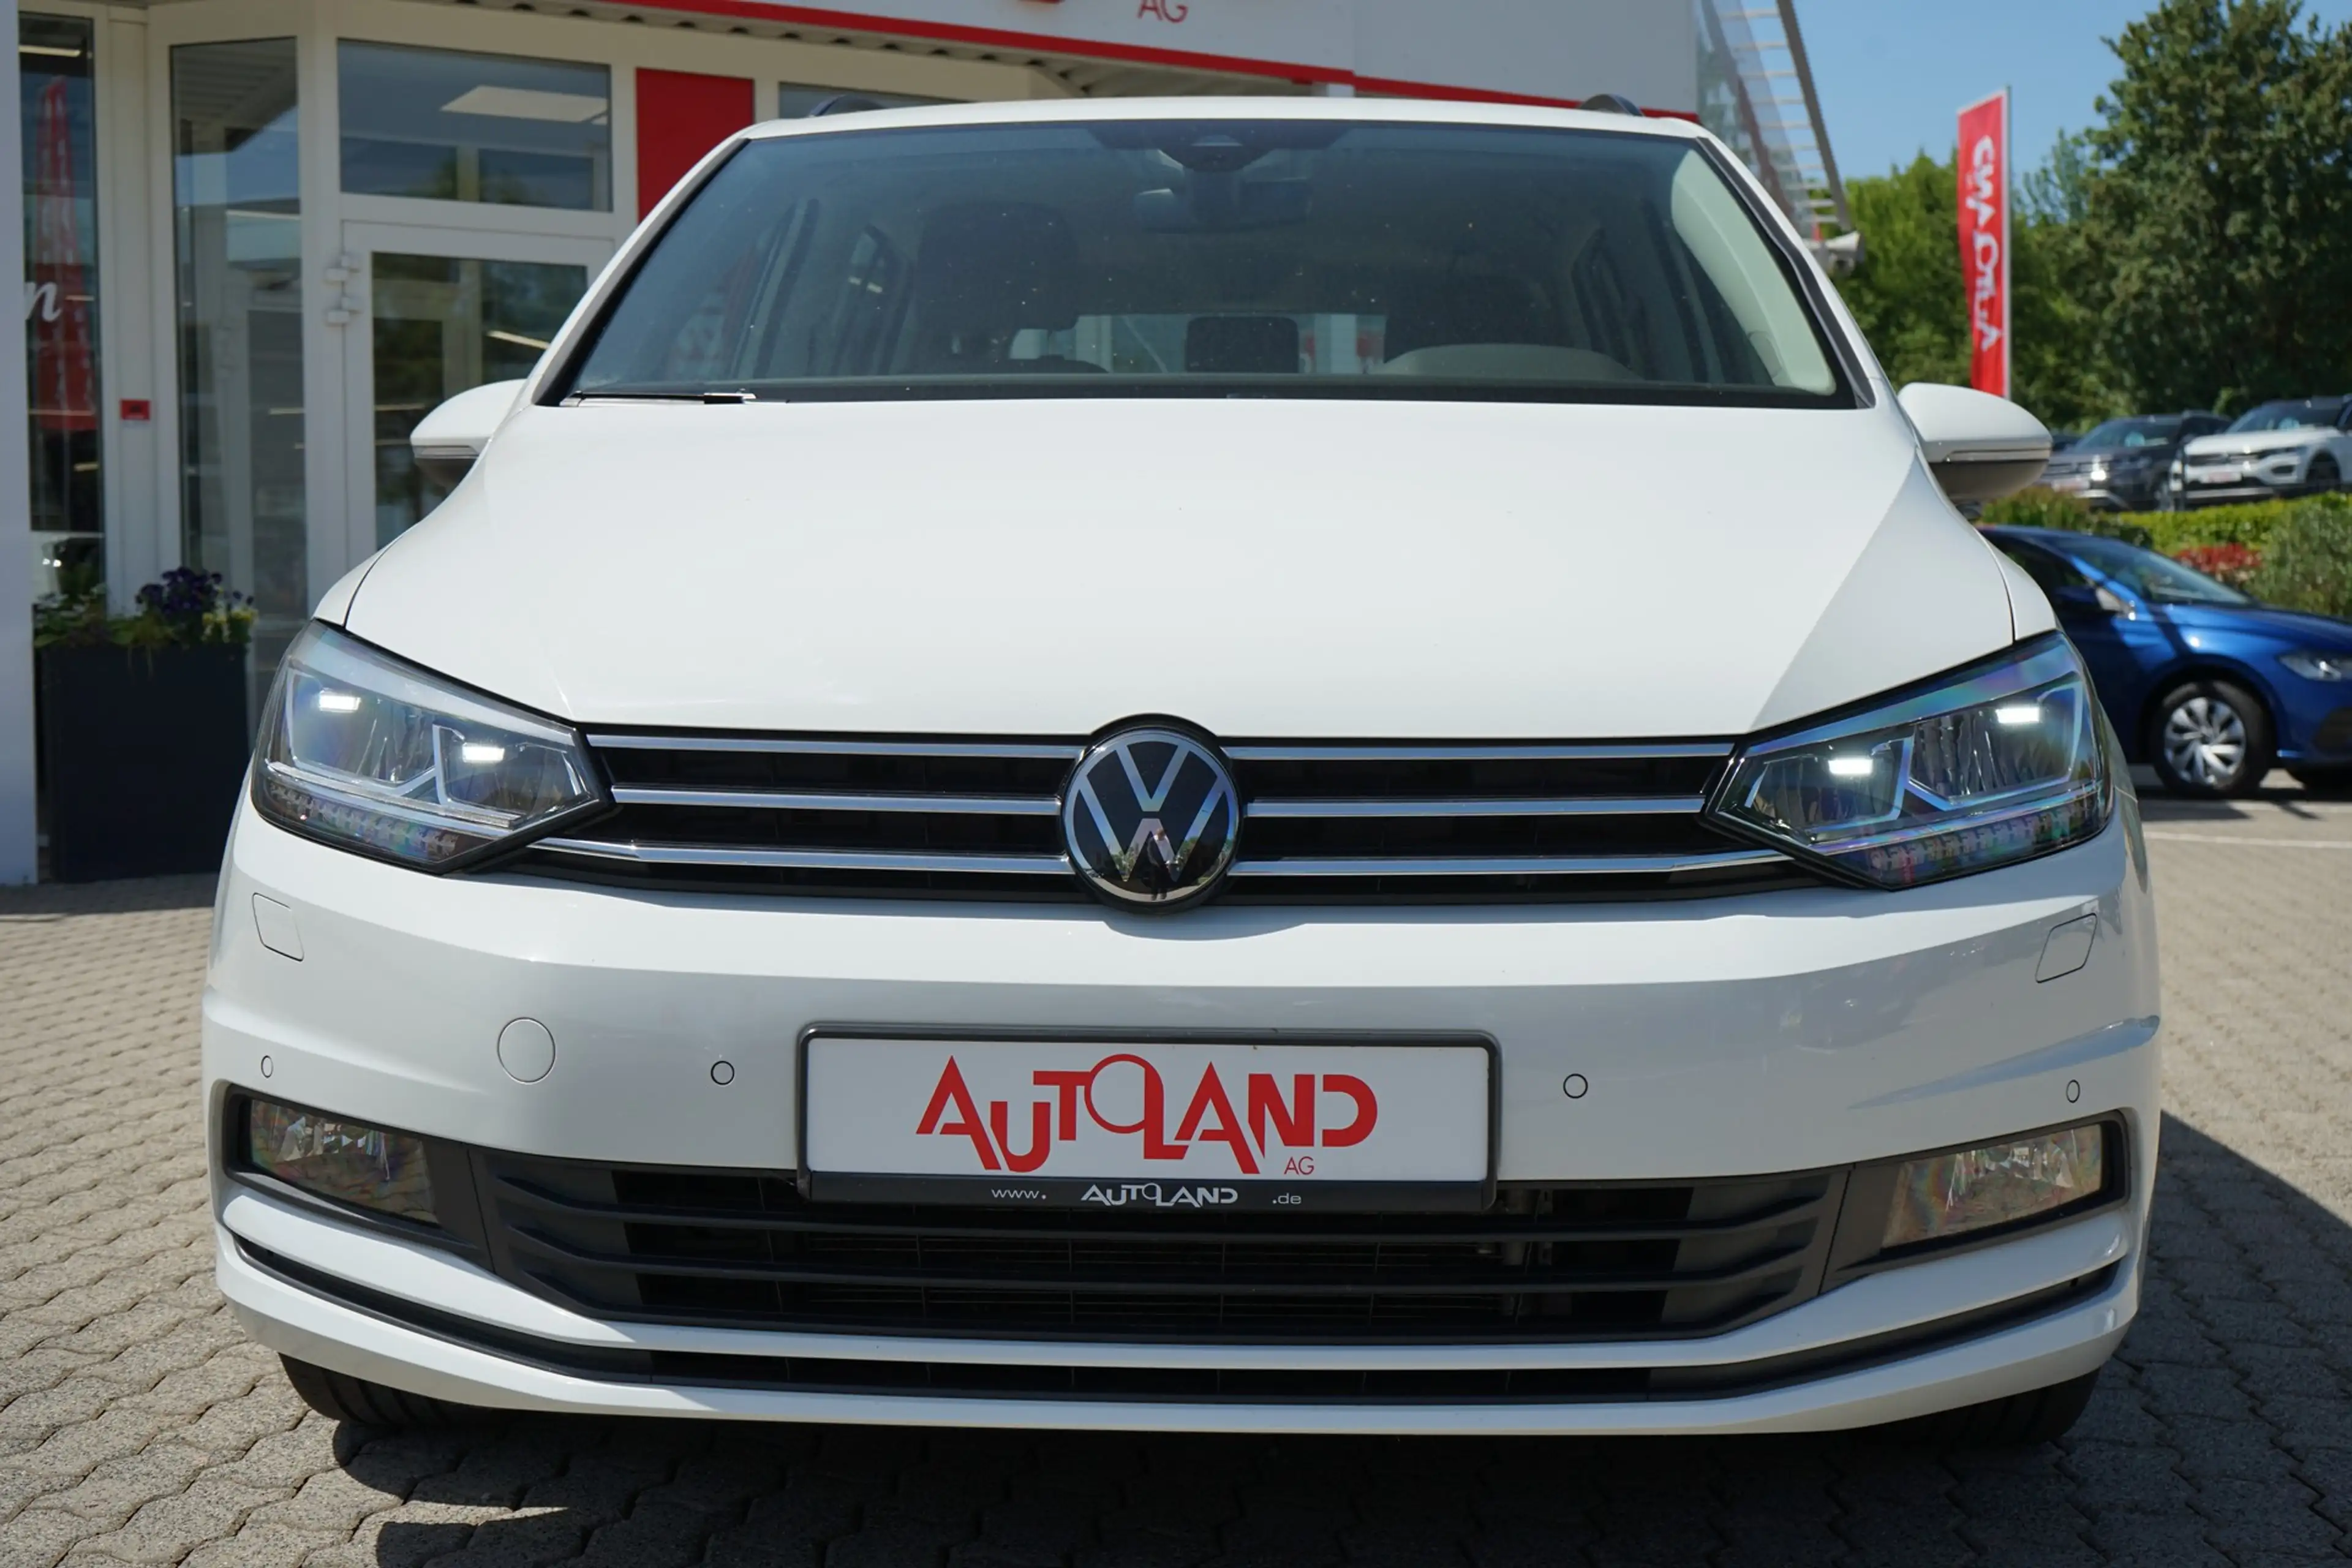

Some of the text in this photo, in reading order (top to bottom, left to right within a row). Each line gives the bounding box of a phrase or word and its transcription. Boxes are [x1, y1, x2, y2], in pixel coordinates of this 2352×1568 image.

[915, 1053, 1378, 1175] AUTOLAND
[1283, 1156, 1315, 1175] AG
[991, 1182, 1302, 1208] www. AUTOLAND .de
